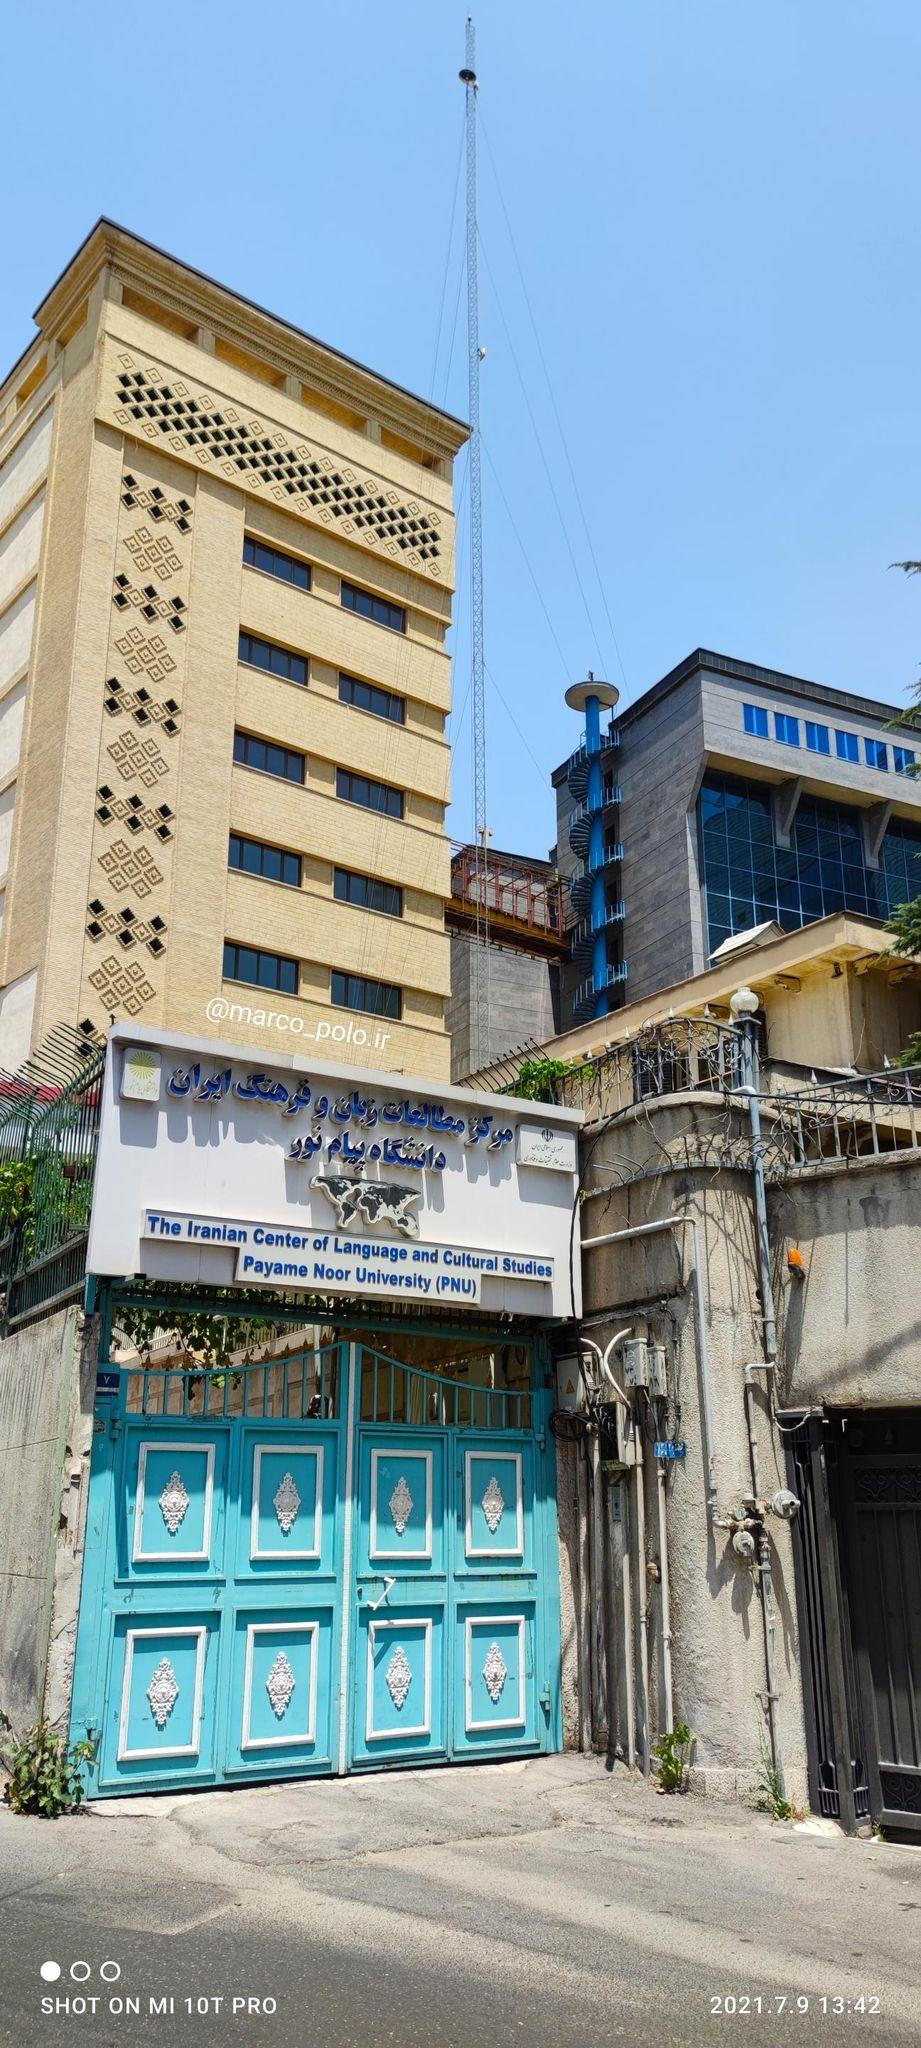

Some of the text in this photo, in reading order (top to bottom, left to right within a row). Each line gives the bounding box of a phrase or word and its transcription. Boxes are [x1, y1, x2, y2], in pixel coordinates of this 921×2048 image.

[167, 1063, 232, 1103] ایران
[233, 1073, 312, 1118] فرهنگ
[312, 1095, 329, 1120] و
[329, 1089, 378, 1130] زبان
[379, 1100, 466, 1137] مطالعات
[285, 1124, 447, 1175] دانشگاه پیام نور
[464, 1116, 514, 1151] مرکز
[148, 1215, 553, 1277] The Iranian Center of Language and Cultural Studies
[243, 1255, 477, 1298] Payame Noor University (PNU)
